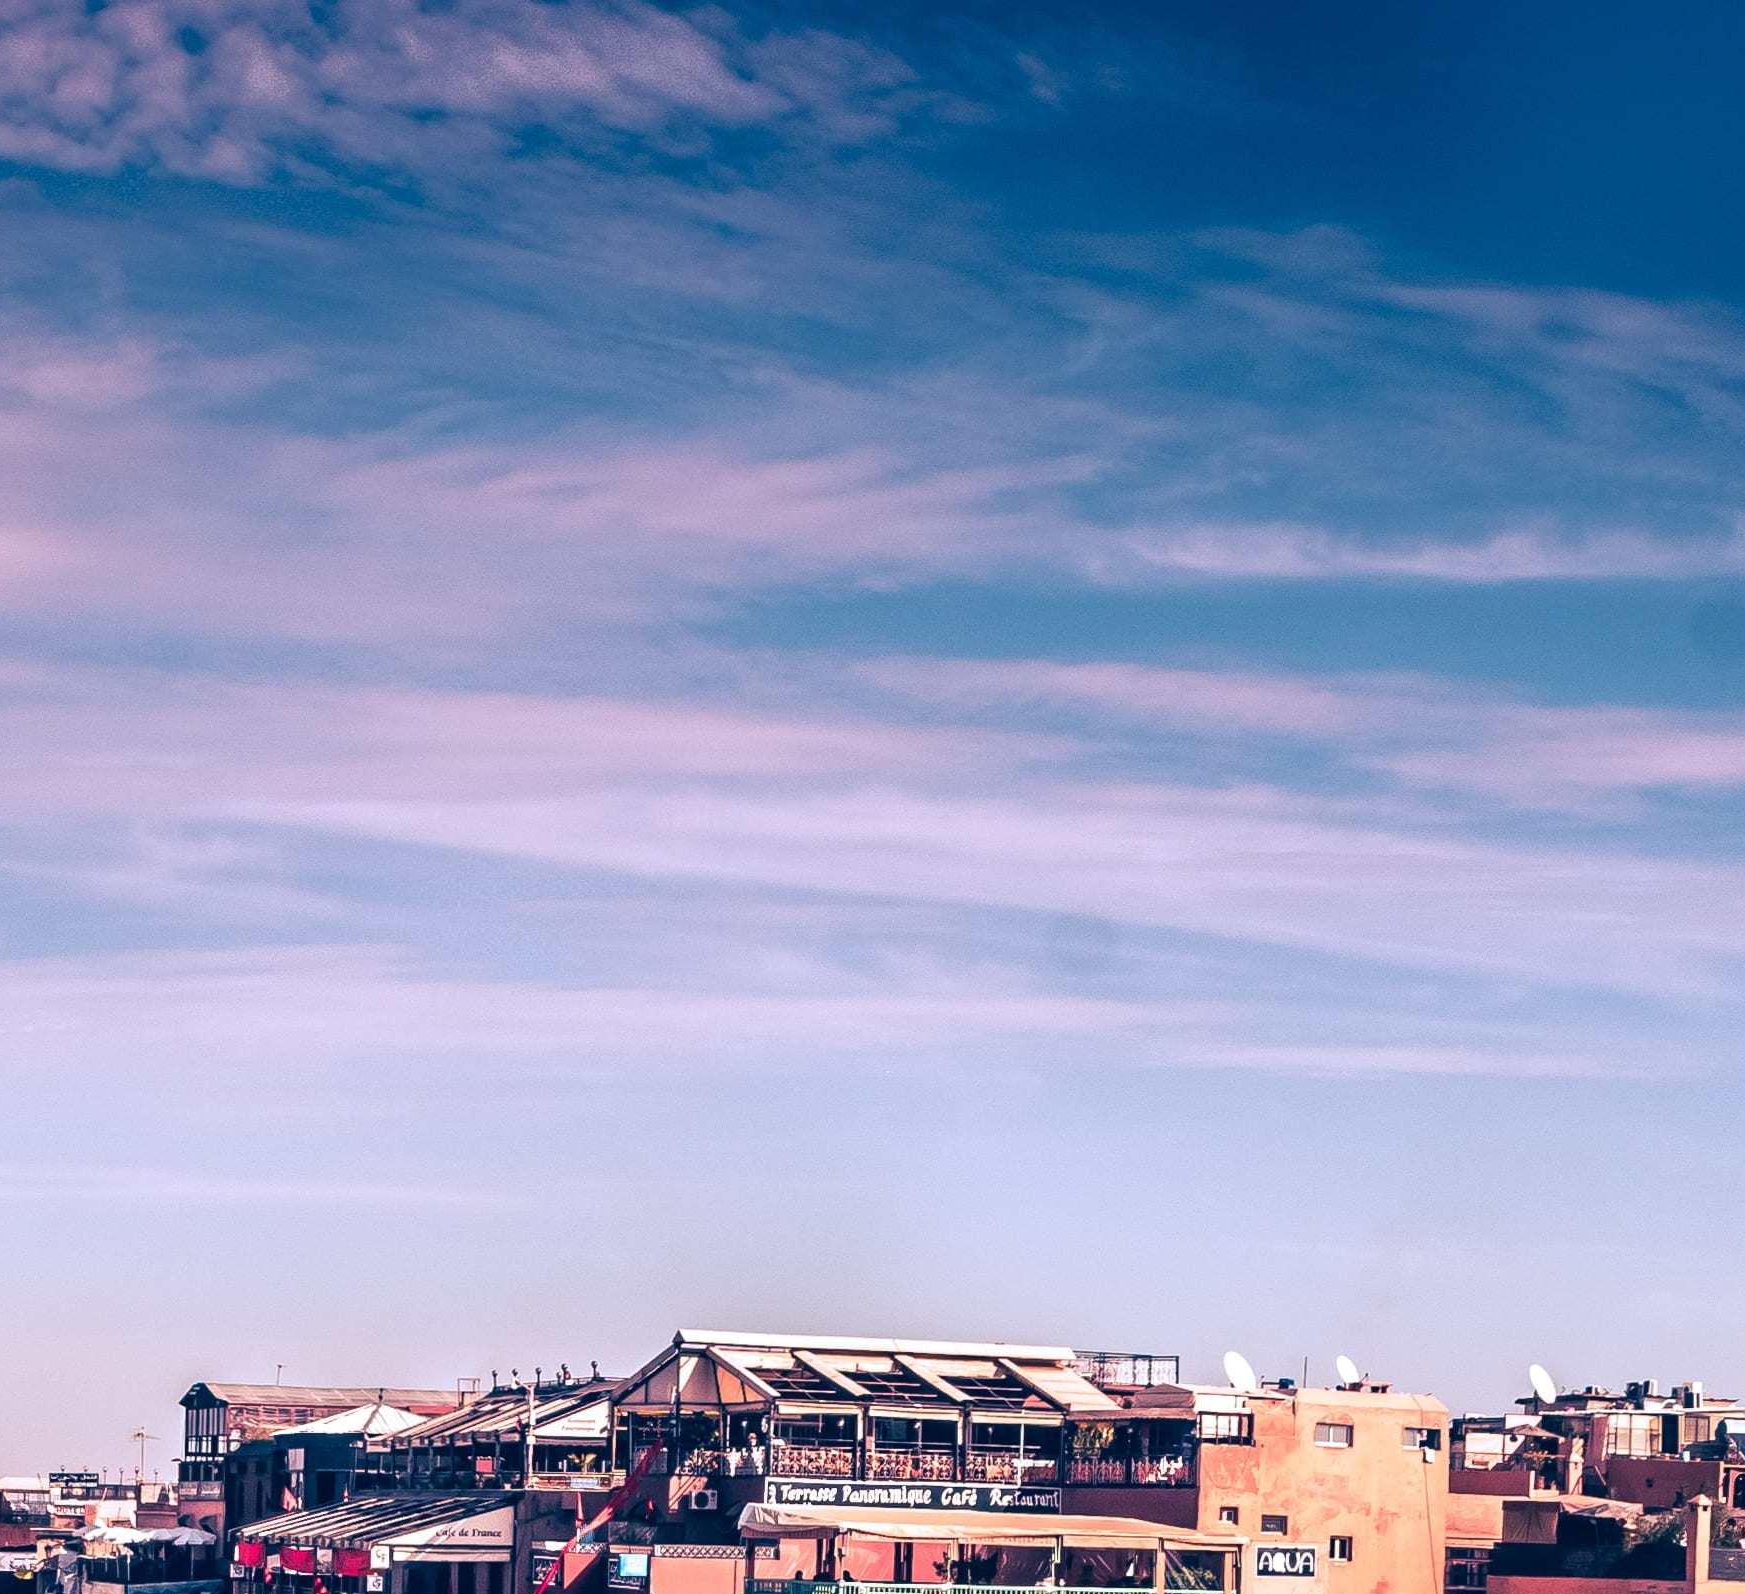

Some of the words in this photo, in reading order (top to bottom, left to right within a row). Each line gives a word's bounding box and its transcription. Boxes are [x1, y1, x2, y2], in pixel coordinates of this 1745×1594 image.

[781, 1485, 837, 1502] Terrasse
[843, 1486, 932, 1505] Panoramique
[990, 1487, 1059, 1507] Restaurant
[458, 1528, 469, 1538] de
[472, 1528, 503, 1538] France
[1258, 1552, 1314, 1573] AQUA
